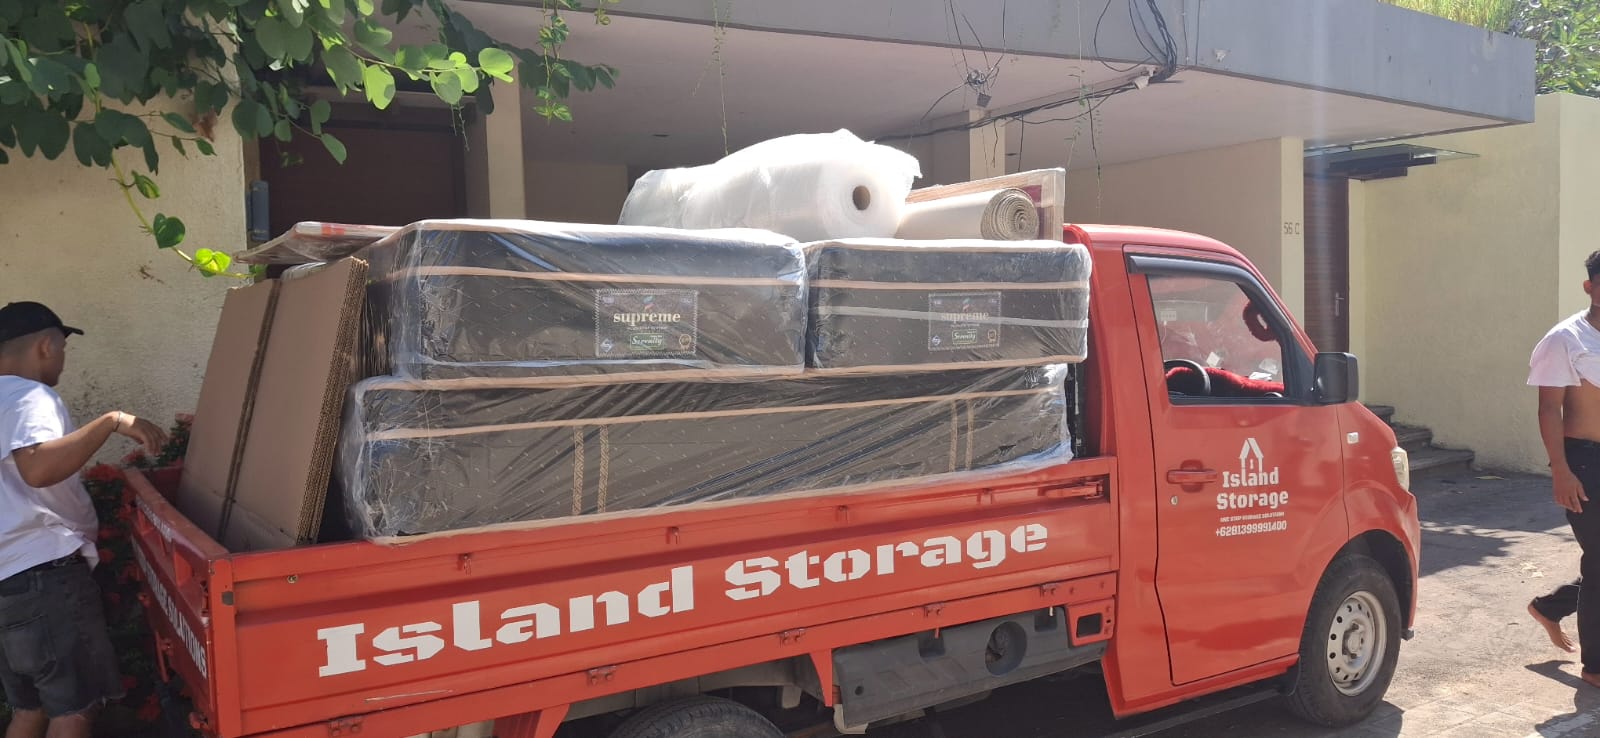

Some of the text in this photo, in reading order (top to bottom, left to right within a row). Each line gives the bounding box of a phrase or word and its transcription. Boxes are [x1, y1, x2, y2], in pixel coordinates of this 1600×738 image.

[613, 311, 681, 327] supreme
[1222, 466, 1279, 488] Island
[1216, 490, 1289, 510] Storage
[317, 523, 1048, 678] Island Storage
